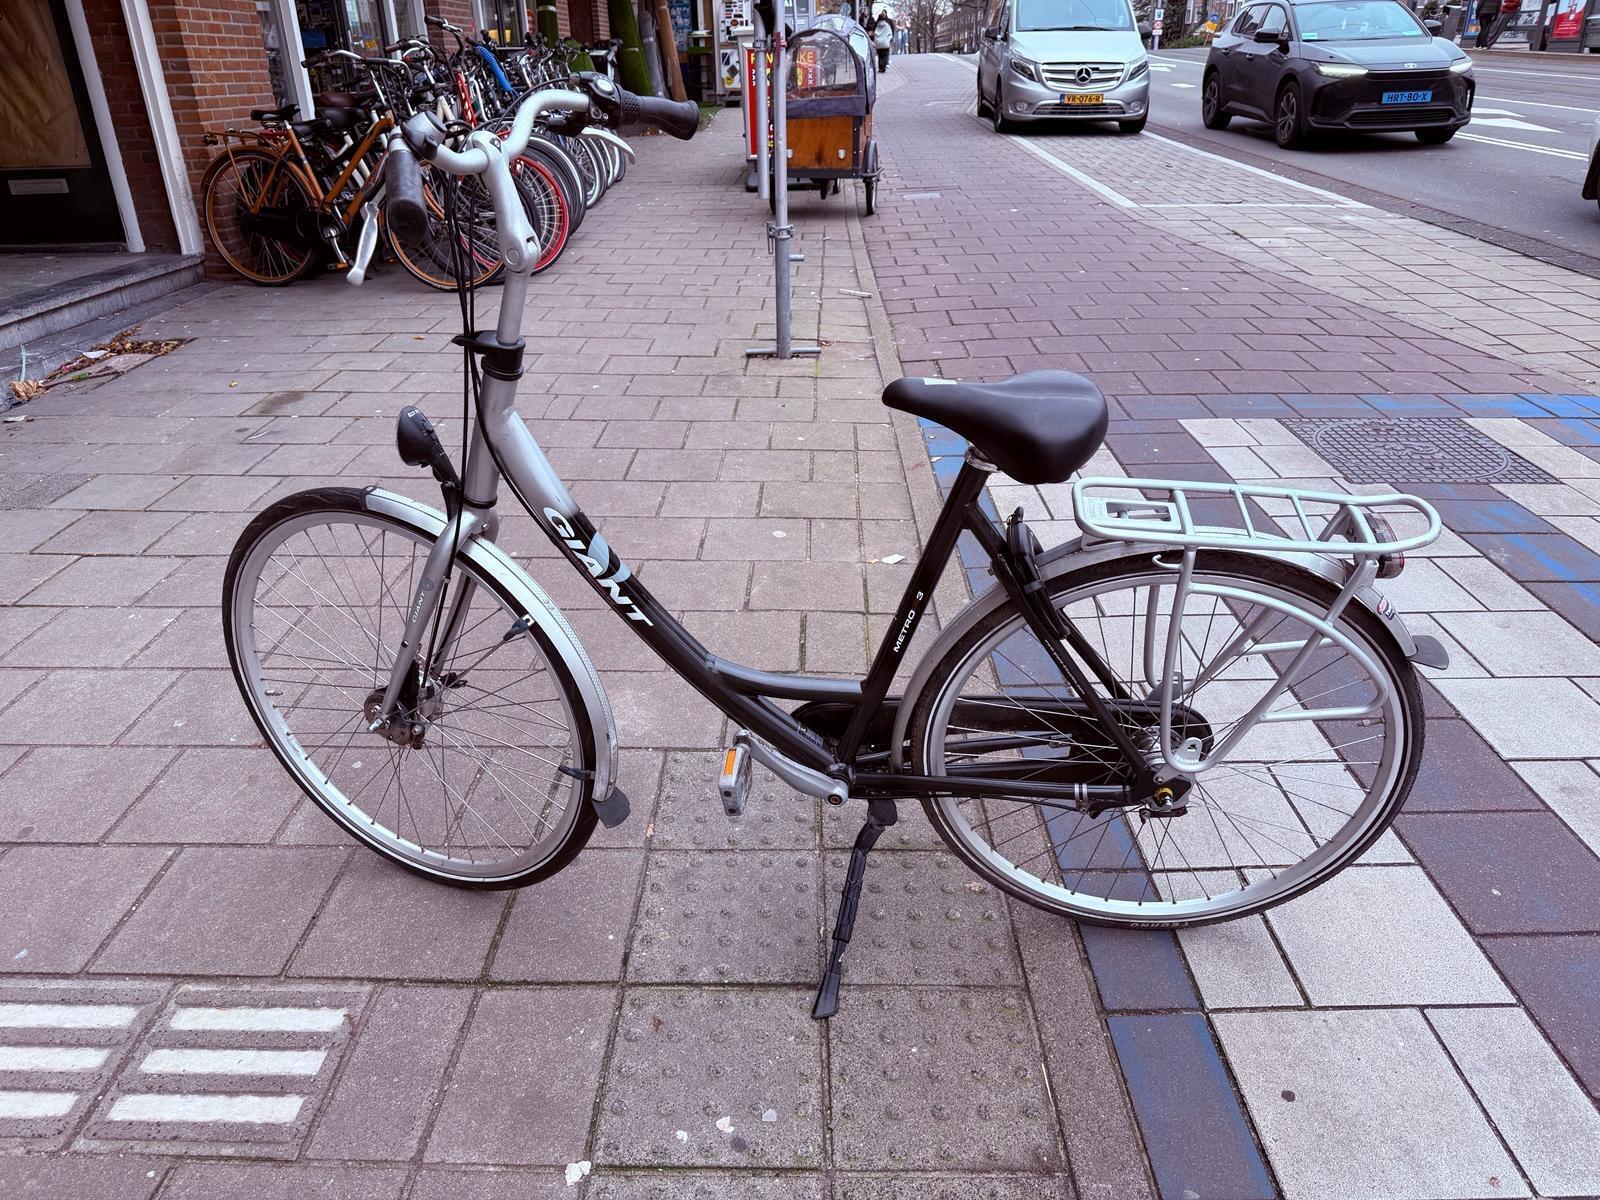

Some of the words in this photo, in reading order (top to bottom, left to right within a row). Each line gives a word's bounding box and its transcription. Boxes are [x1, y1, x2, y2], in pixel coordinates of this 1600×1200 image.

[1066, 95, 1101, 103] VR-076-R
[543, 507, 654, 627] GIANT
[412, 590, 425, 623] GIANT
[893, 609, 916, 653] METRO
[916, 591, 924, 601] 3
